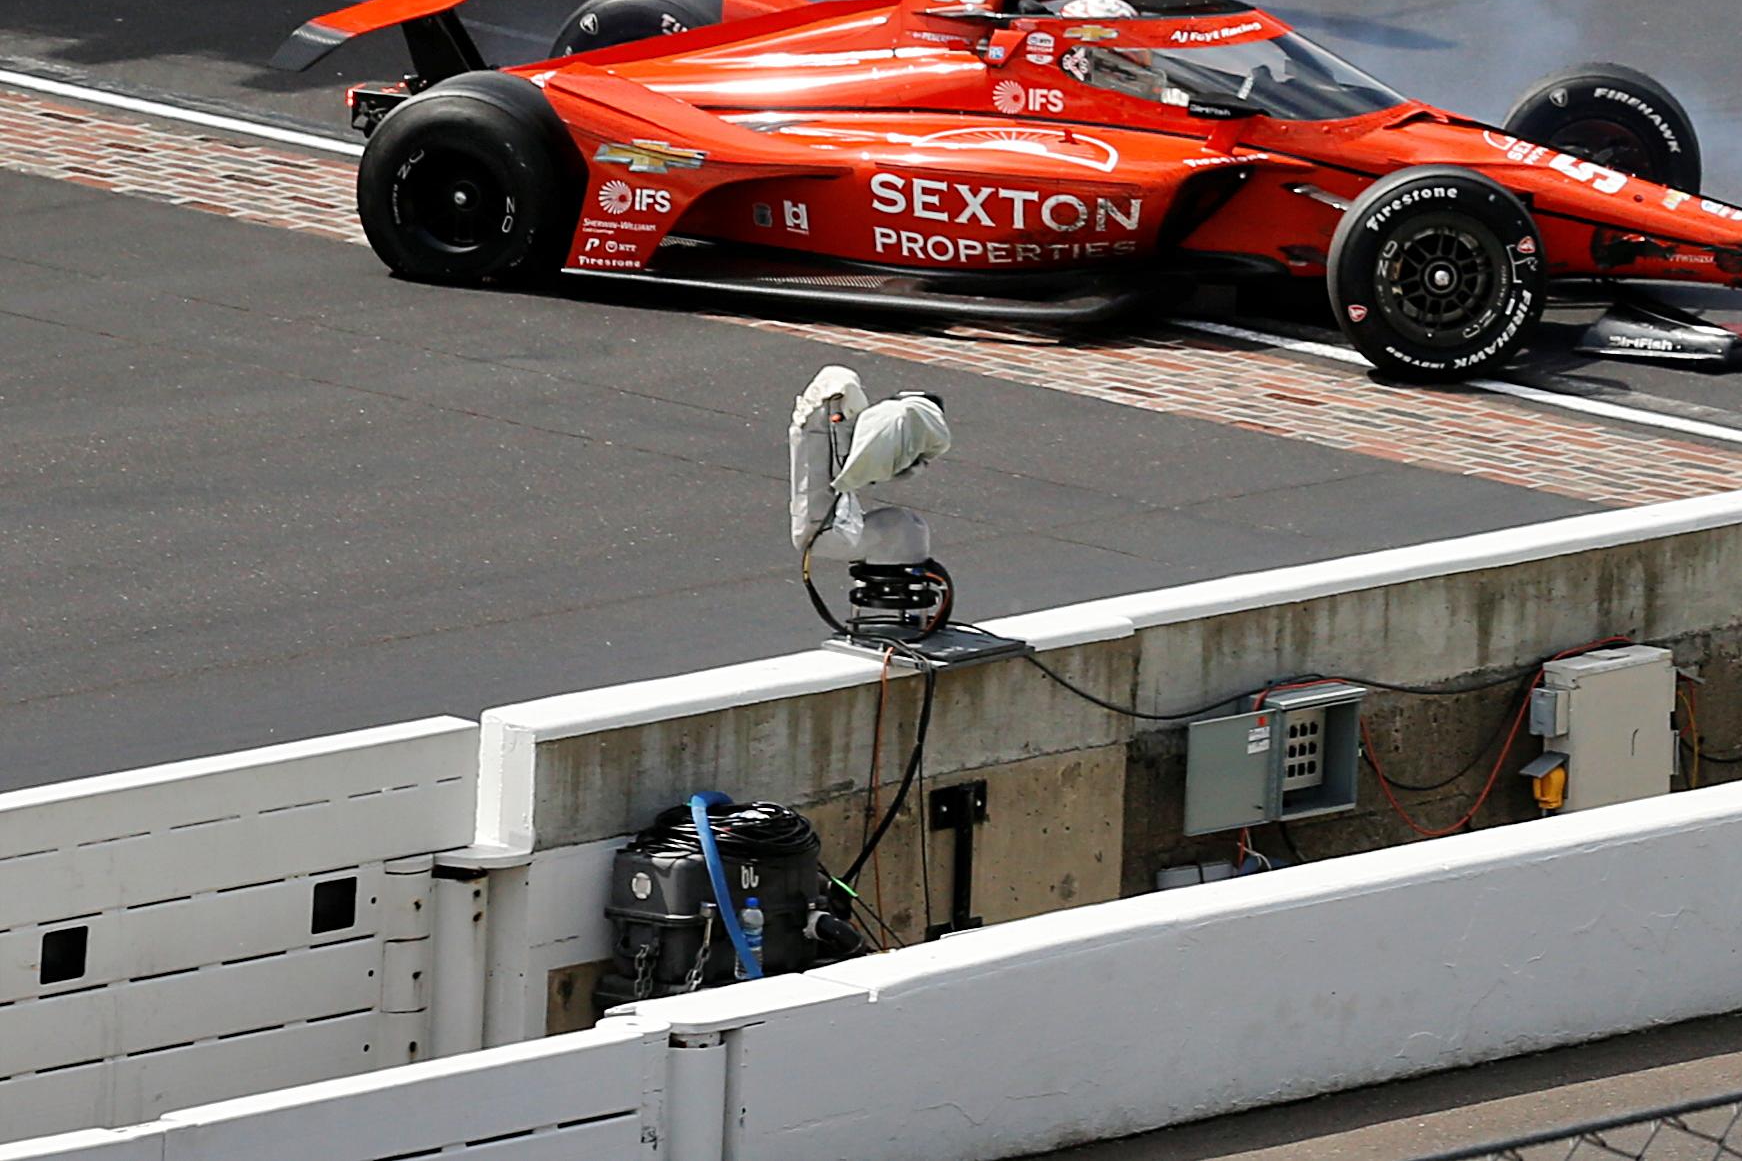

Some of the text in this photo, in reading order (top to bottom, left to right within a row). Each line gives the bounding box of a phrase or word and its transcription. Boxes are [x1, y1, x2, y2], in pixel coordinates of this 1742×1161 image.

[1171, 31, 1188, 43] AJ
[1028, 88, 1064, 113] IFS
[1594, 87, 1681, 154] FIREHAWK
[634, 188, 671, 213] IFS
[870, 172, 1142, 232] SEXTON
[1365, 187, 1458, 231] Firestone
[578, 255, 641, 268] Firestone
[873, 226, 1136, 264] PROPERTIES
[1453, 289, 1533, 369] FIREHAWK
